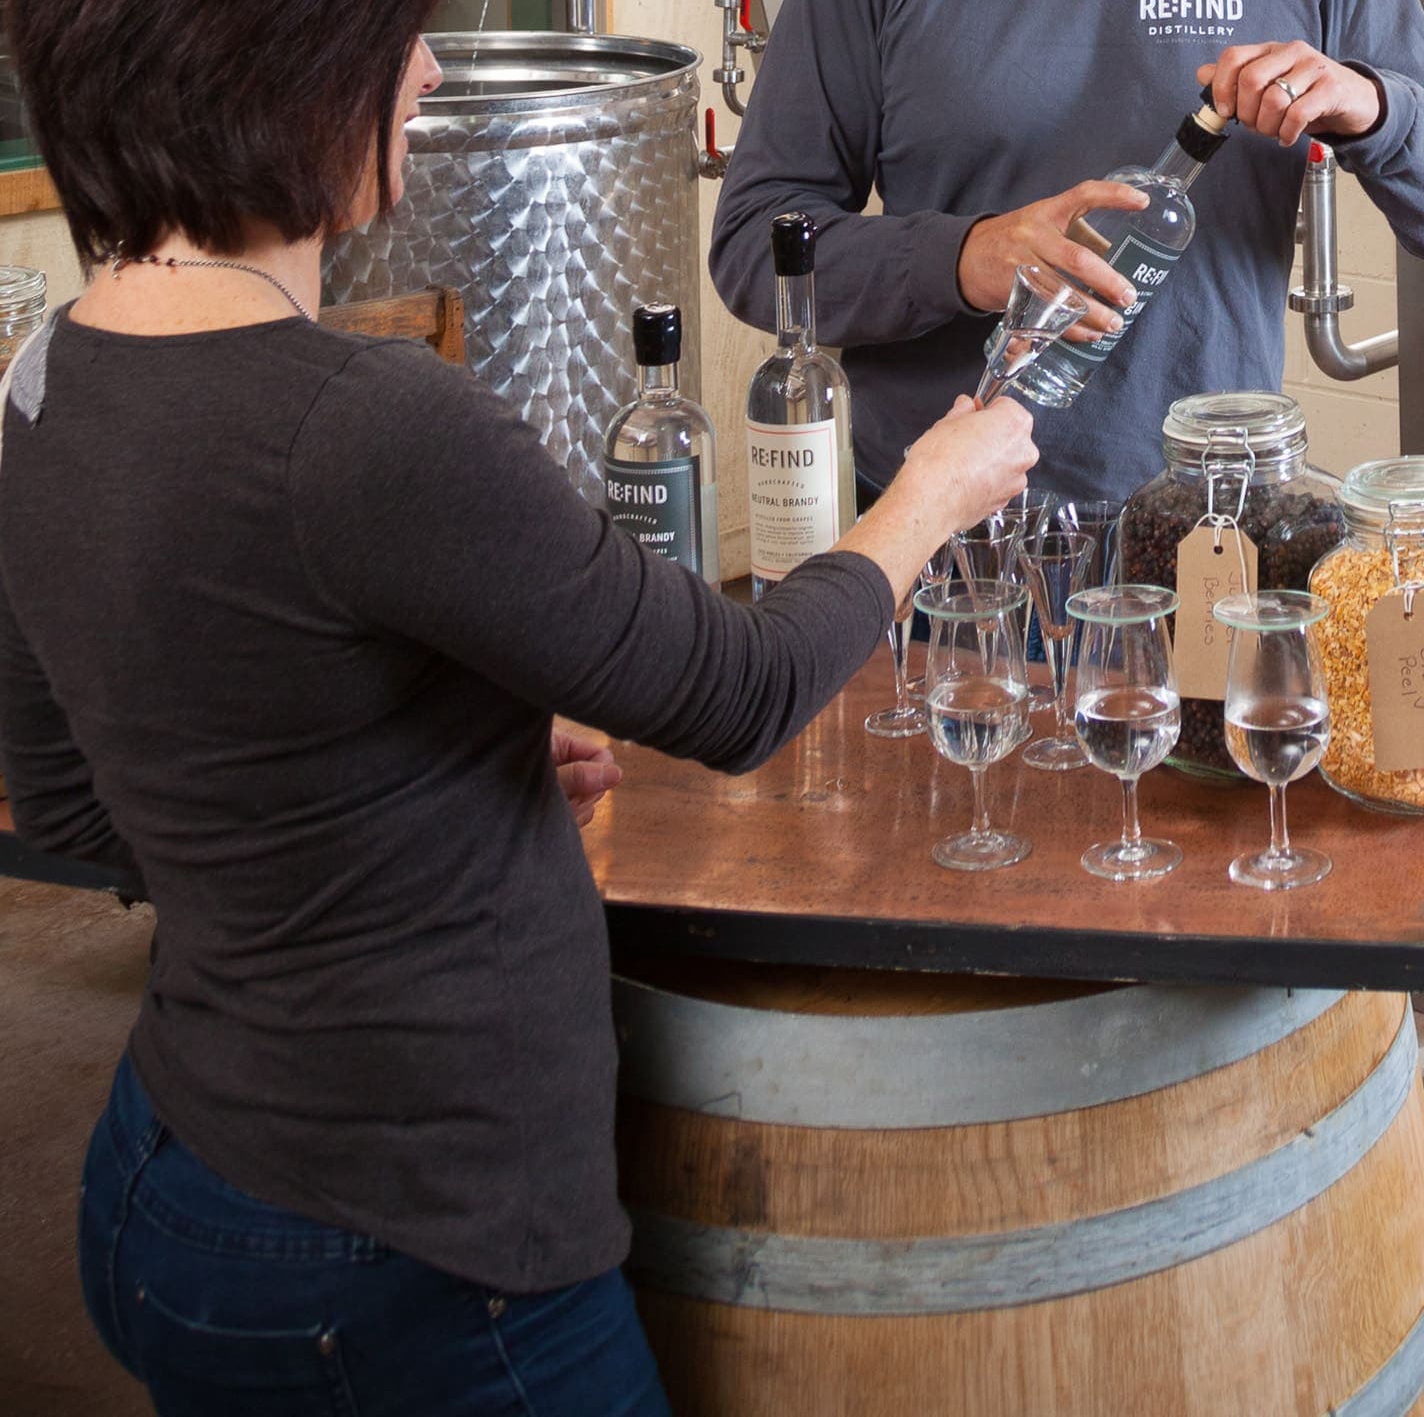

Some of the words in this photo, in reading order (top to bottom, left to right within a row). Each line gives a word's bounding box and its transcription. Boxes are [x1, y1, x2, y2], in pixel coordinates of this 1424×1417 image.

[1149, 24, 1235, 36] DISTILLERY
[751, 445, 815, 469] RE:FIND
[606, 479, 668, 505] RE:FIND
[782, 496, 820, 508] BRANDY
[639, 530, 676, 543] BRANDY
[1202, 576, 1220, 646] Berries
[1397, 655, 1418, 698] Peel
